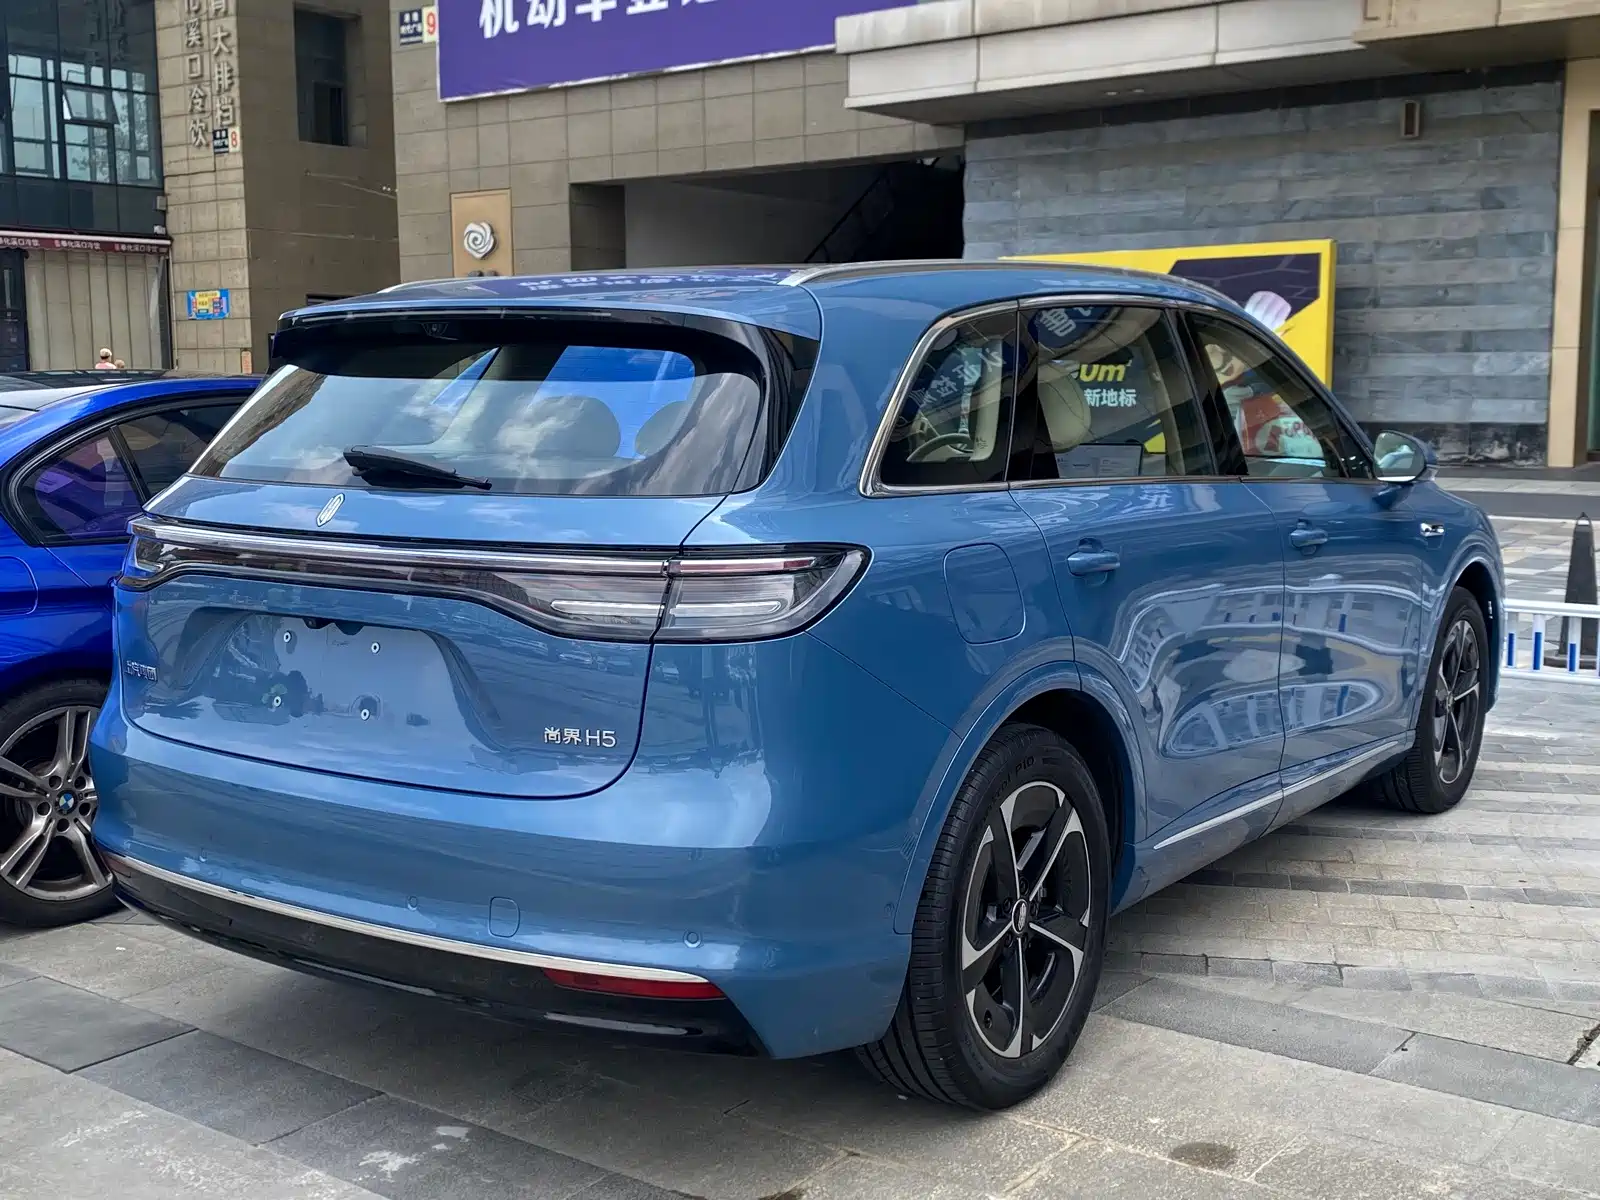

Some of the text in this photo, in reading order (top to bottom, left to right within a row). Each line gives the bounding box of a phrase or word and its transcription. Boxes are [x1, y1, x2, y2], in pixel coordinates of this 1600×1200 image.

[426, 12, 436, 35] 9
[231, 131, 238, 148] 8
[1084, 388, 1137, 408] 新地标
[544, 726, 616, 748] 尚界 H5
